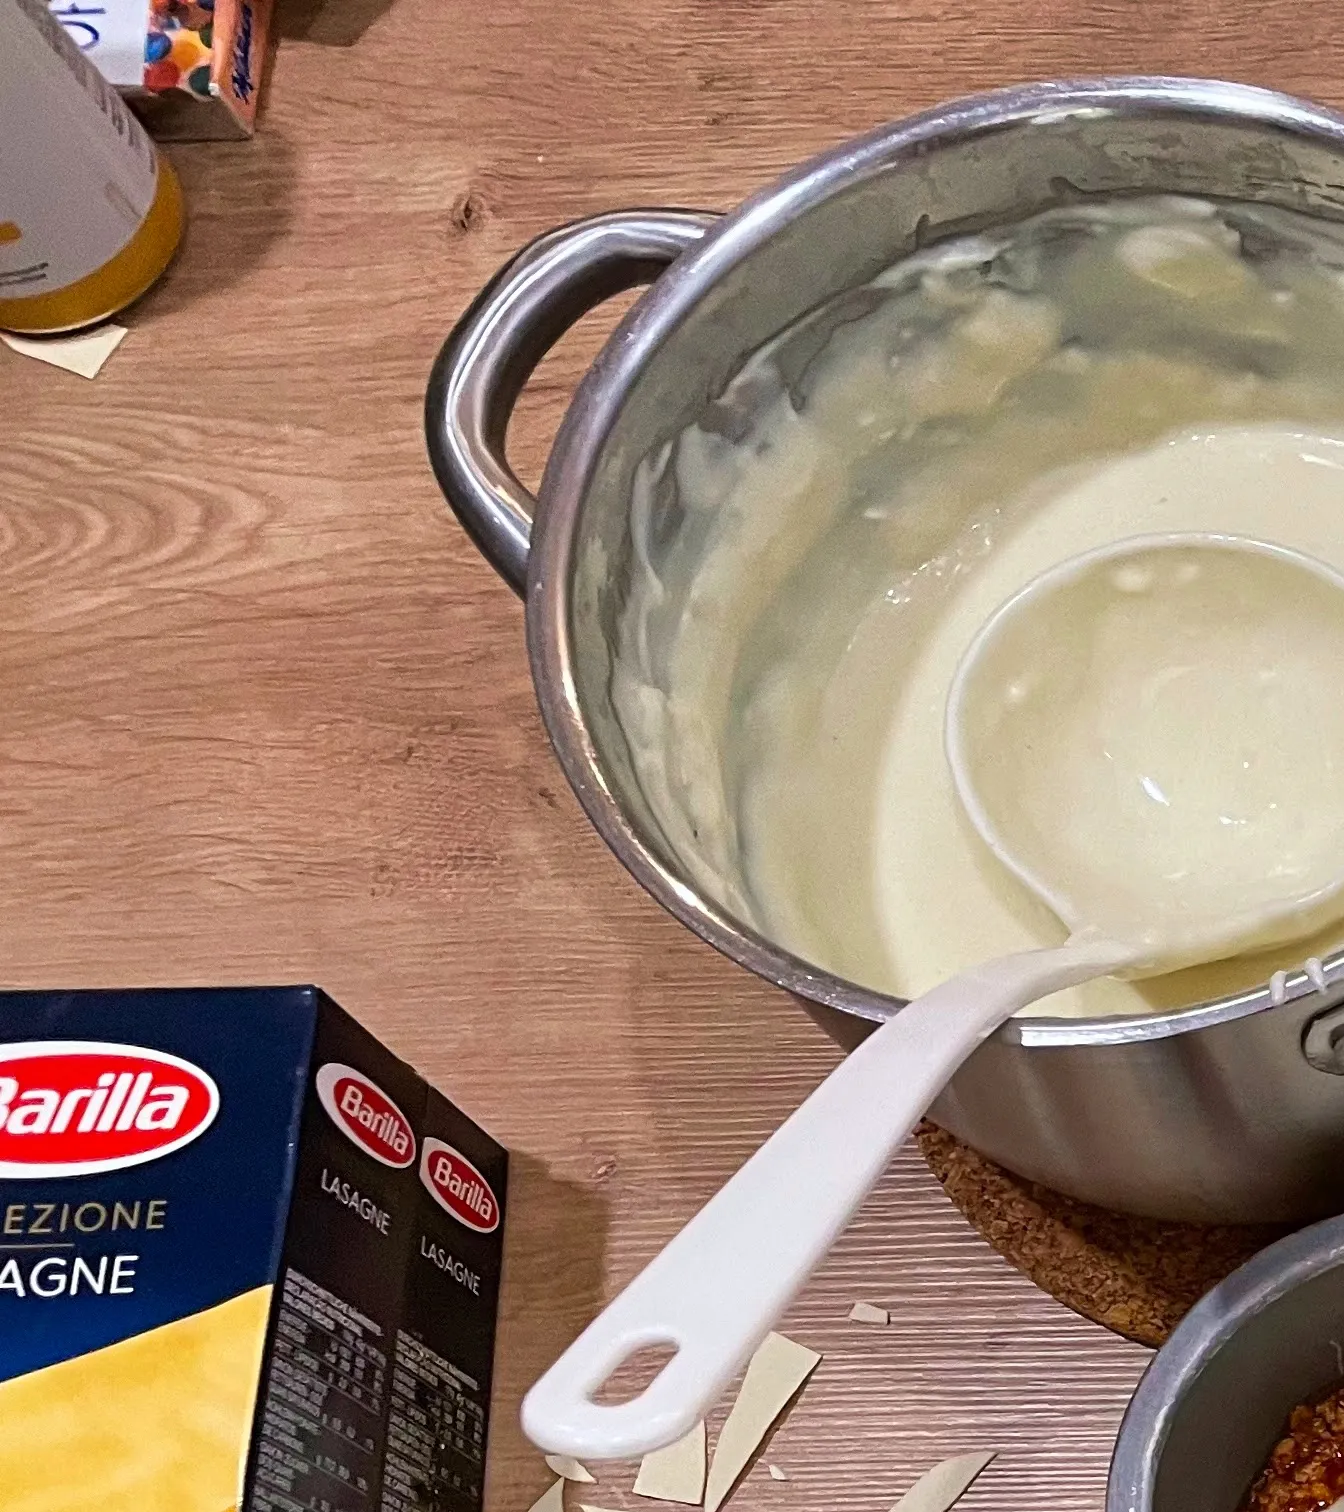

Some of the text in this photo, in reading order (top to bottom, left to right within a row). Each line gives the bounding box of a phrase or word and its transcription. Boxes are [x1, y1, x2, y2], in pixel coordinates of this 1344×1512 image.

[340, 1085, 409, 1155] Barilla
[321, 1168, 391, 1236] LASAGNE
[434, 1157, 494, 1221] Barilla
[421, 1235, 481, 1296] LASAGNE
